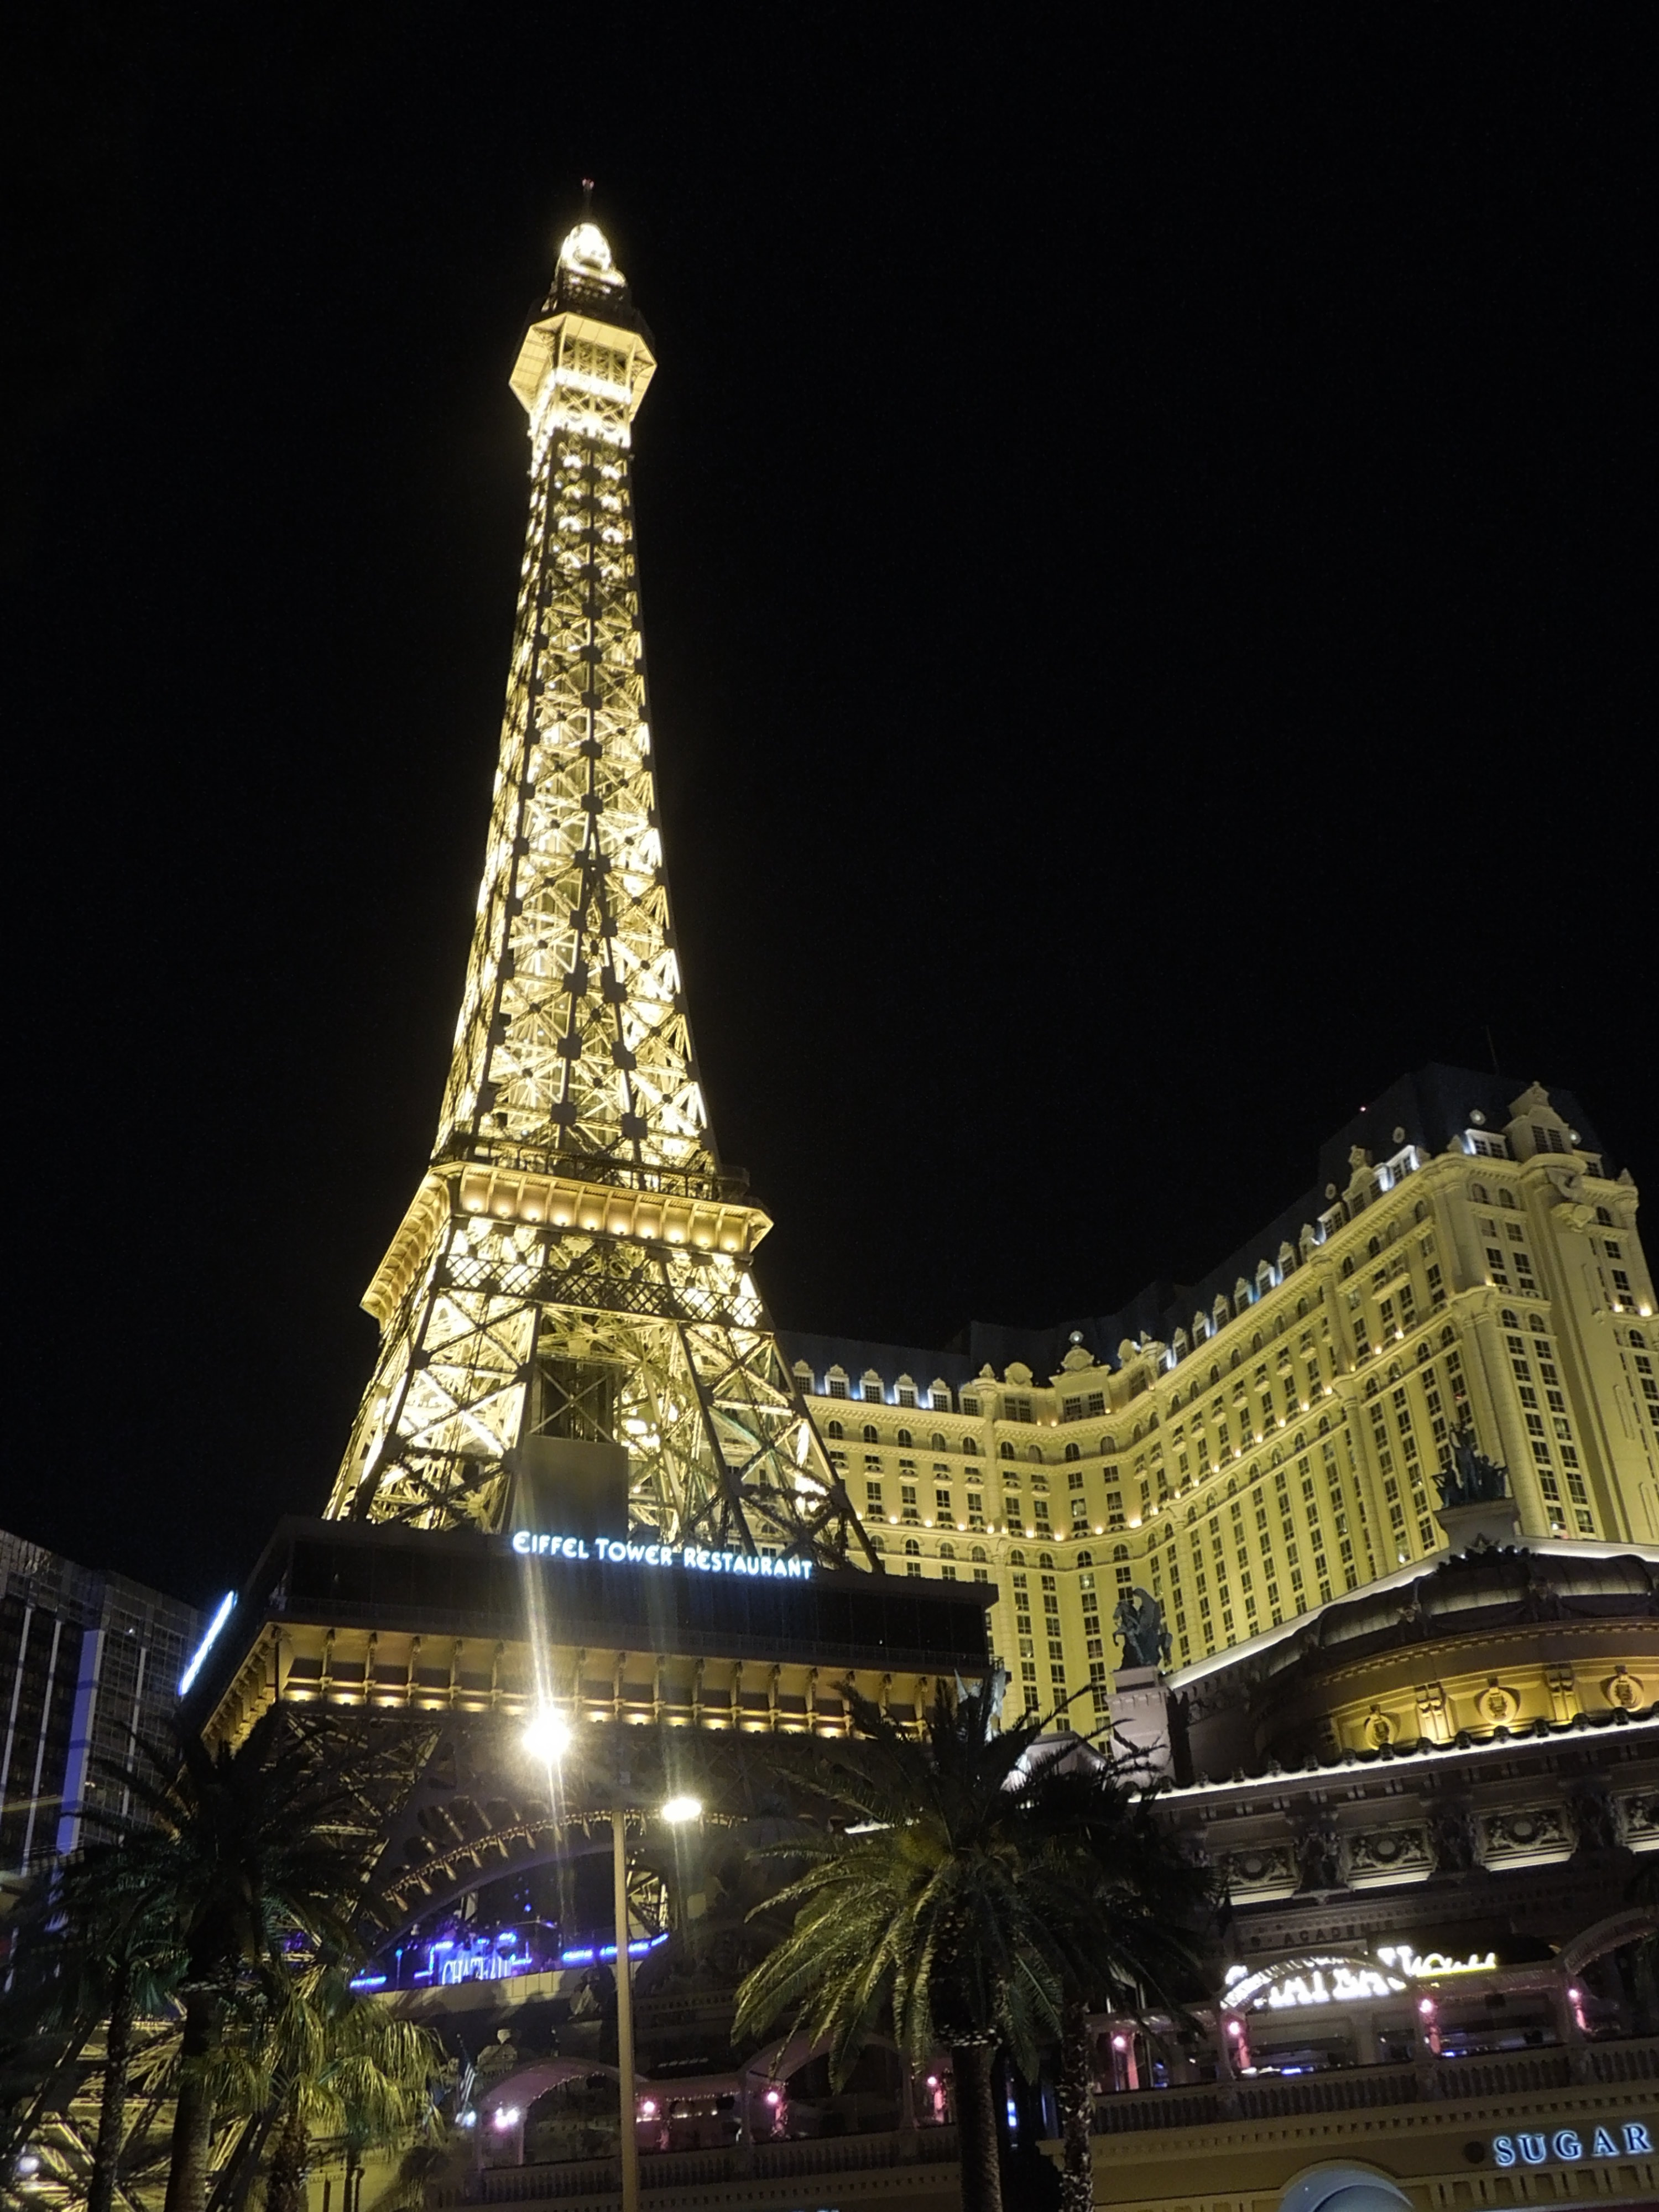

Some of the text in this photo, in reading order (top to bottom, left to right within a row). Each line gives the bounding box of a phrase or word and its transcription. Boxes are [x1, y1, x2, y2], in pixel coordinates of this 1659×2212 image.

[513, 1531, 813, 1580] EIFFEL TOWER RESTAURANT
[1494, 2123, 1653, 2166] SUGAR
